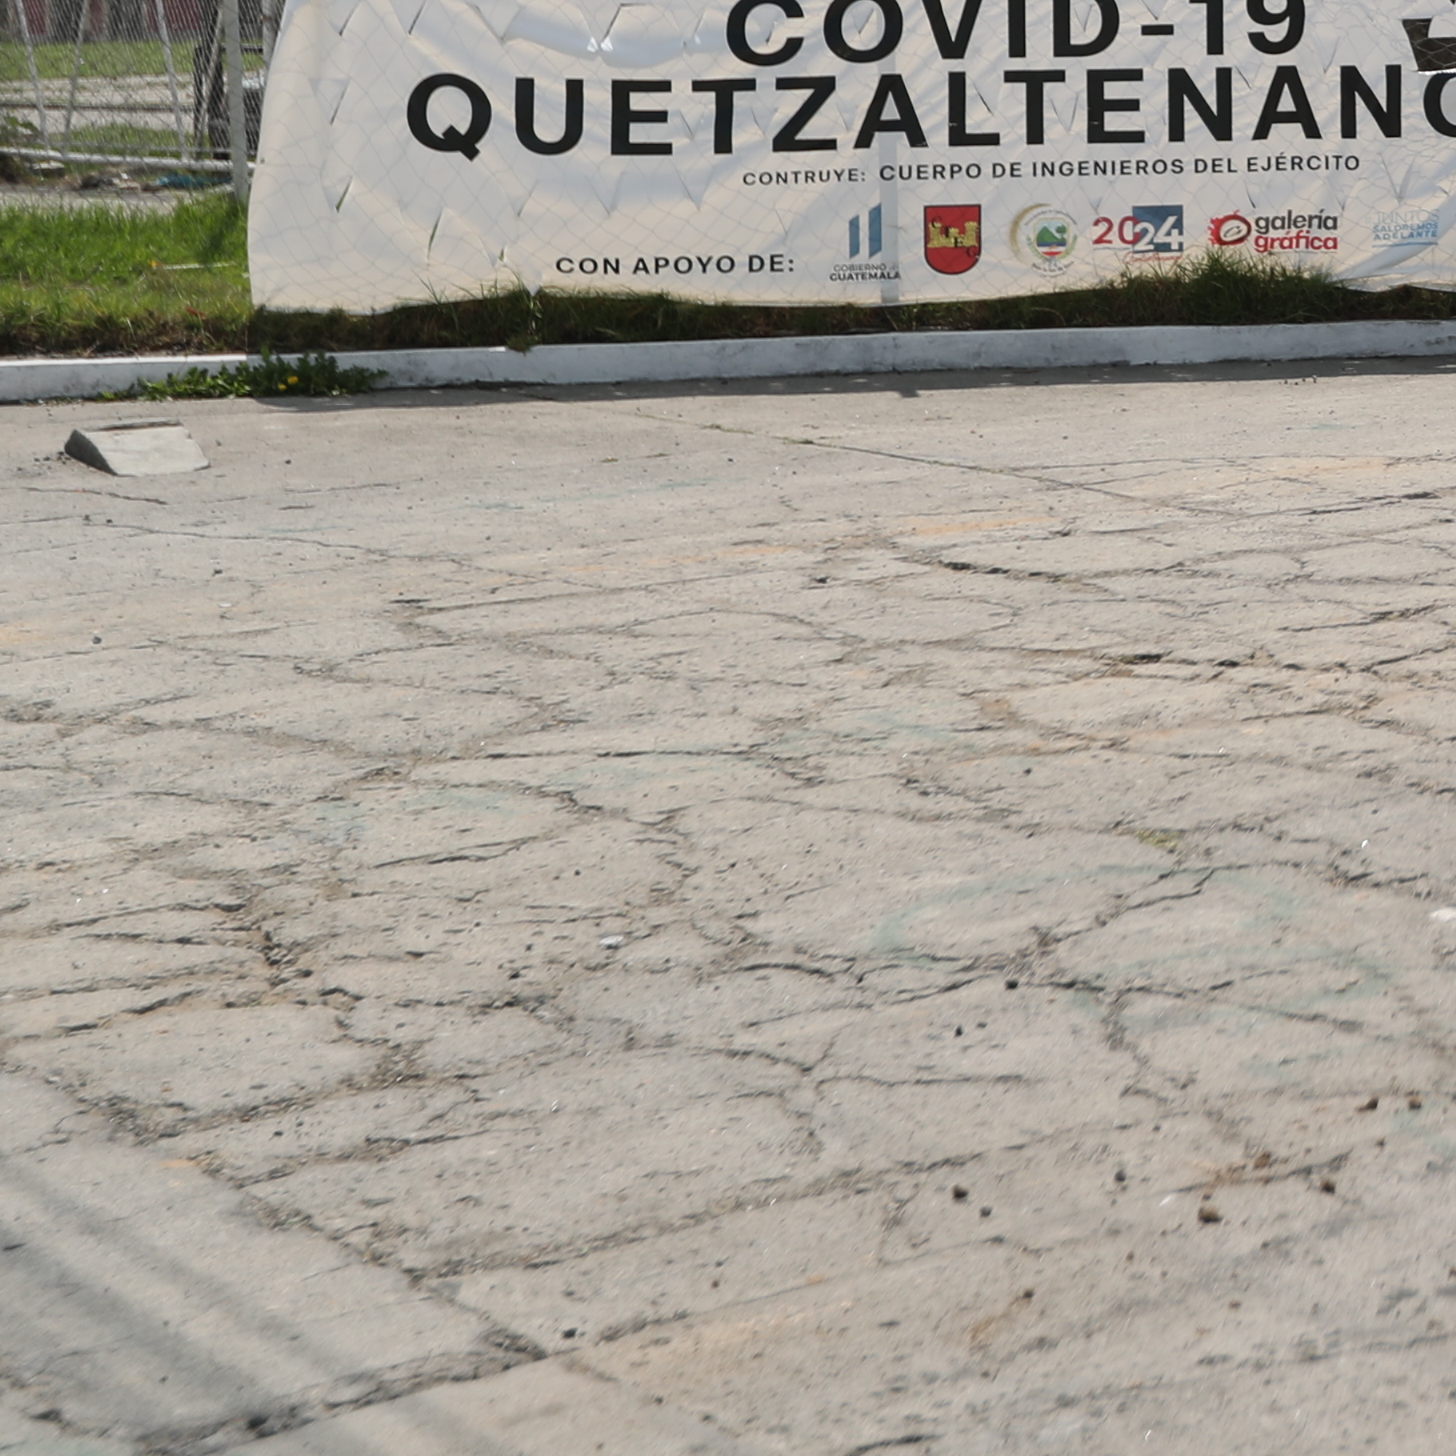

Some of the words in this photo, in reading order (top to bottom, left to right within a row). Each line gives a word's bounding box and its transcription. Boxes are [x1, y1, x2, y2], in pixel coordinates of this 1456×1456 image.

[742, 168, 866, 186] CONTRUYE:
[879, 163, 982, 182] CUERPO
[992, 162, 1022, 179] DE
[1032, 158, 1184, 178] INGENIEROS
[1194, 157, 1238, 174] DEL
[1247, 152, 1360, 173] EJÉRCITO
[1254, 209, 1338, 234] galería
[1377, 208, 1439, 224] JUNTOS
[1372, 222, 1439, 232] SALDREMOS
[1254, 229, 1338, 253] gráfica
[1373, 230, 1438, 241] ADELANTE
[555, 257, 620, 275] CON
[632, 255, 736, 275] APOYO
[748, 254, 794, 273] DE:
[833, 262, 887, 272] GOBIERNO
[829, 271, 902, 282] GUATEMALA
